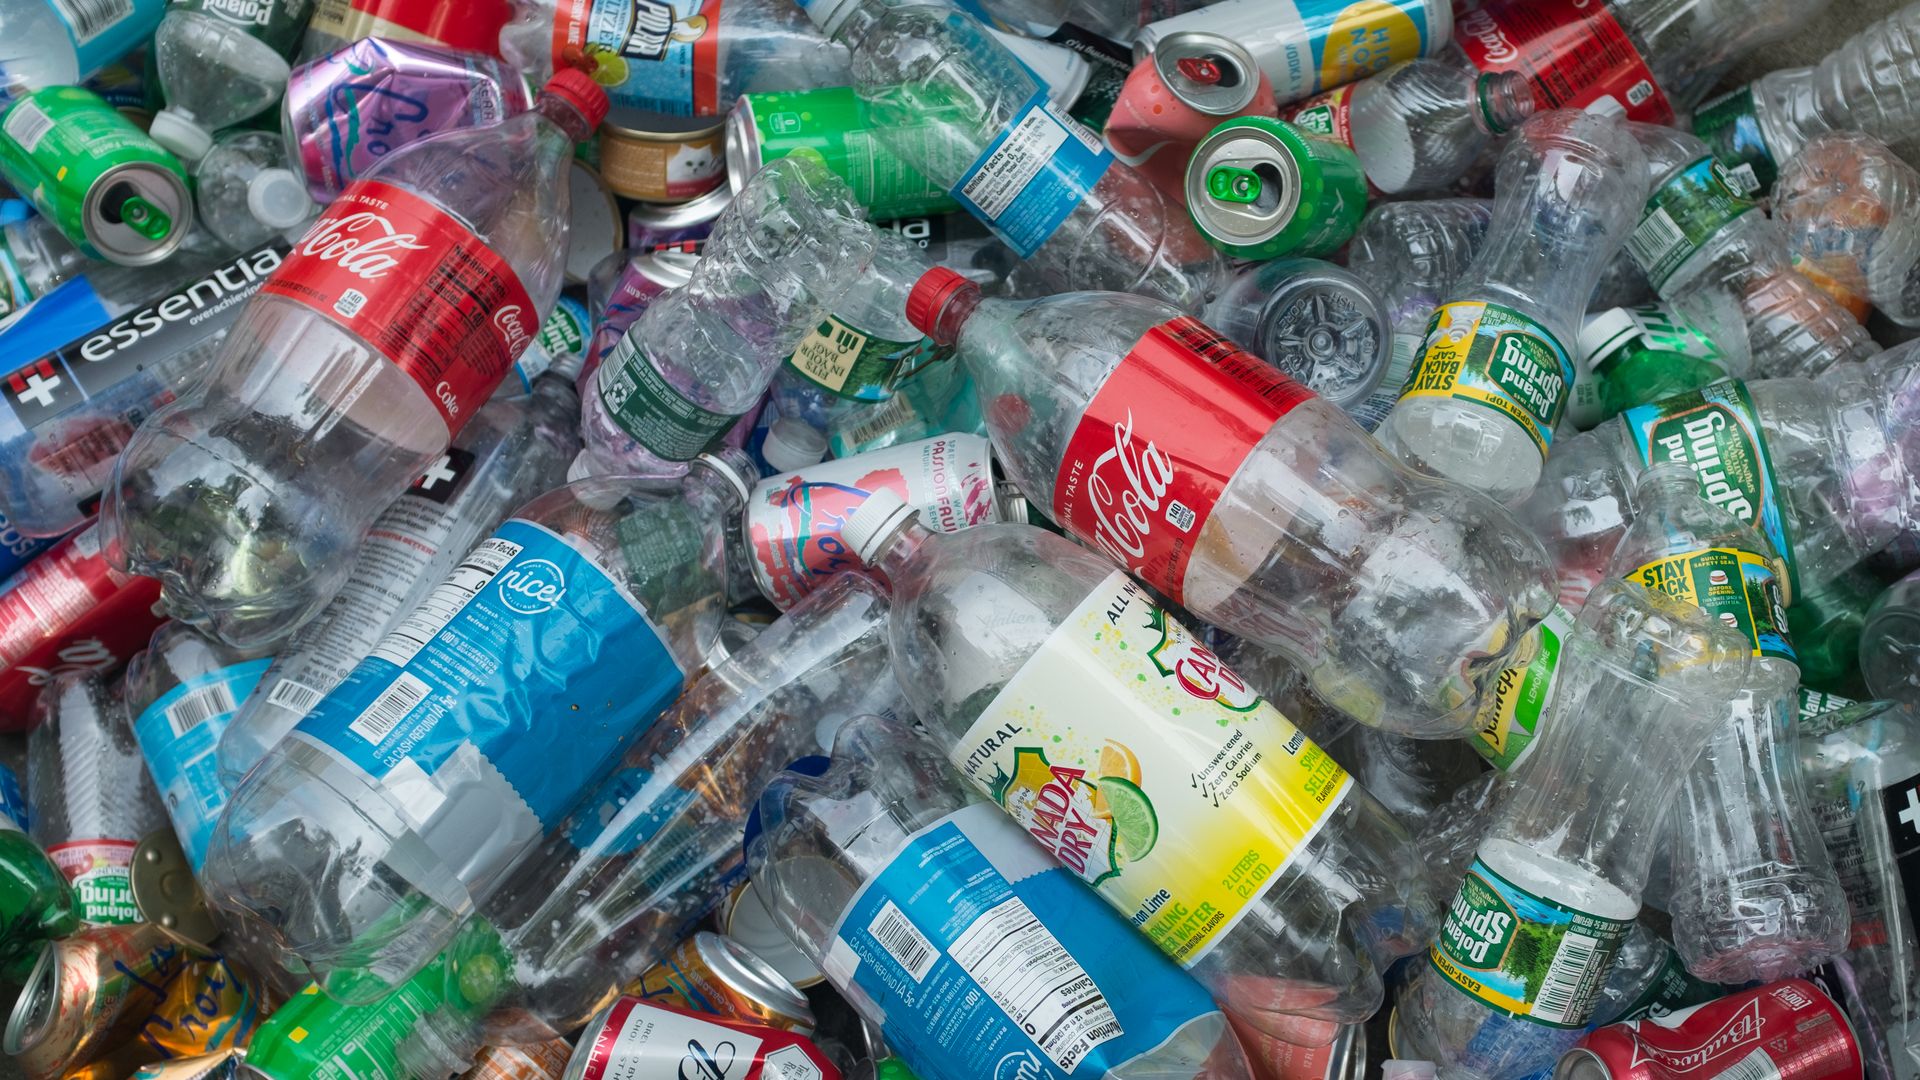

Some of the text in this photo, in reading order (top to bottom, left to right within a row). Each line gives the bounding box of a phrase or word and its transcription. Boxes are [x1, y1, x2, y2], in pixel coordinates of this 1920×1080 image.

[625, 0, 673, 59] POLAR
[1284, 43, 1302, 81] VODKA
[962, 170, 987, 196] Nutrition
[983, 150, 1004, 172] Facts
[992, 158, 1011, 178] Calories
[357, 194, 386, 214] TASTE
[450, 244, 491, 278] Nutrition
[75, 241, 285, 366] essentia
[346, 291, 362, 305] 140
[797, 343, 845, 377] IN YOUR
[811, 341, 839, 362] BAG!
[1424, 355, 1459, 377] BACK
[1431, 350, 1456, 360] CAP
[803, 360, 829, 380] FITS
[1417, 369, 1454, 392] STAY
[1495, 335, 1567, 404] Spring
[436, 380, 459, 419] Coke
[1484, 393, 1509, 408] TOP!
[1496, 366, 1554, 418] Poland
[1059, 458, 1089, 498] TASTE
[1681, 407, 1754, 529] Spring
[929, 440, 957, 532] PASSIONFRUI
[1167, 502, 1182, 519] 140
[494, 539, 519, 558] Facts
[474, 578, 486, 592] 0
[496, 560, 568, 610] nice!
[1642, 558, 1686, 587] STAY
[465, 614, 490, 631] Refresh
[475, 601, 499, 619] Refresh
[1106, 594, 1130, 626] ALL
[453, 644, 497, 675] GUARANTEED
[457, 640, 500, 670] SATISFACTION
[1176, 639, 1222, 700] CAN
[1522, 648, 1552, 704] LEMON LIME
[430, 701, 448, 719] IA
[407, 711, 439, 744] REFUND
[383, 750, 402, 770] CA
[390, 735, 416, 762] CASH
[967, 723, 1023, 778] NATURAL
[1199, 729, 1244, 781] Unsweetened
[1207, 739, 1255, 792] Zero Calories
[1219, 752, 1264, 801] Zero Sodium
[1016, 787, 1032, 803] 1904
[1030, 765, 1085, 852] NADA
[1058, 809, 1099, 873] DRY
[1222, 850, 1261, 893] 2 LITERS
[1236, 861, 1273, 900] (2.1 QT)
[1147, 887, 1169, 913] Lime
[1448, 876, 1511, 946] Spring
[1148, 901, 1184, 942] RKLING
[1176, 901, 1213, 940] WATER
[1184, 929, 1205, 950] NATURAL
[1201, 909, 1225, 935] FLAVORS
[1449, 908, 1488, 962] Poland
[1571, 914, 1594, 927] REFUND
[847, 936, 861, 950] CA
[856, 945, 876, 967] CASH
[871, 961, 897, 990] REFUND
[891, 980, 909, 999] IA
[1058, 963, 1067, 973] Fat
[1433, 954, 1484, 992] EASY-OPEN
[1022, 969, 1094, 1036] Calories 0
[1074, 1012, 1083, 1021] 12
[935, 1007, 963, 1043] GUARANTEED
[939, 1011, 967, 1047] SATISFACTION
[974, 1016, 994, 1041] Refresh
[987, 1026, 1007, 1051] Refresh
[1042, 1029, 1065, 1054] (360mL)
[1053, 1030, 1076, 1056] container
[1060, 1018, 1125, 1072] Nutrition Facts
[625, 1066, 635, 1079] BY
